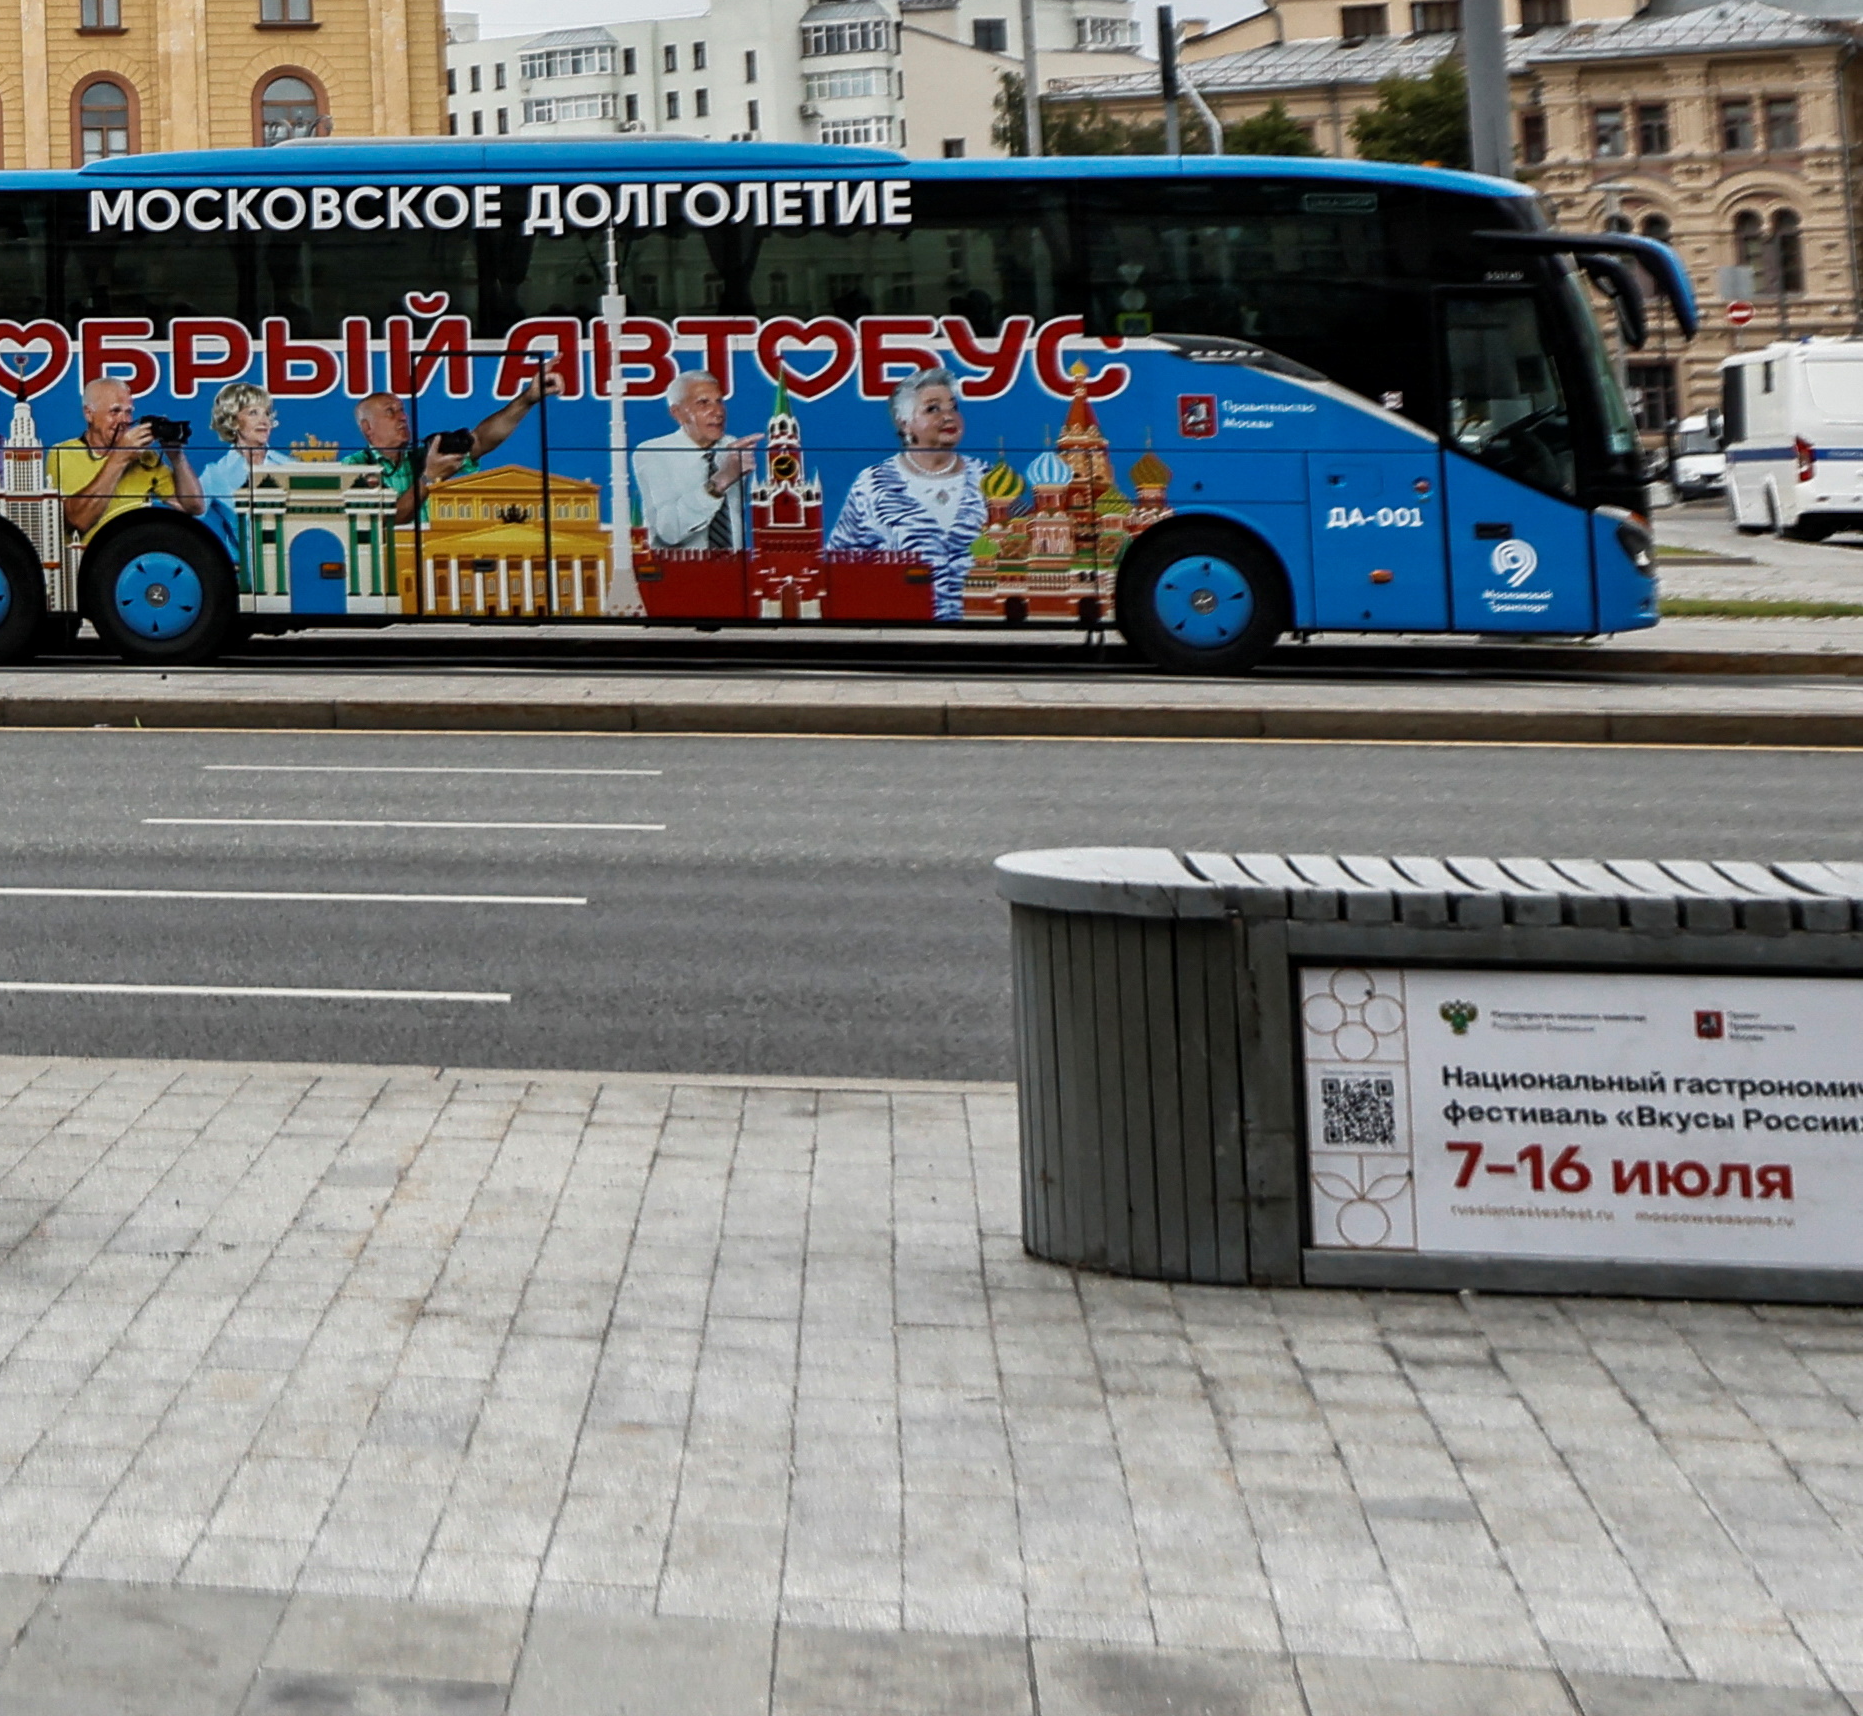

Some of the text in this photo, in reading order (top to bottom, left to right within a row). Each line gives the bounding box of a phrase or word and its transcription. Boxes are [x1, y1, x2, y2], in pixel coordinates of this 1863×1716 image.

[90, 181, 913, 236] МОСКОВСКОЕ ДОЛГОЛЕТИЕ
[493, 315, 1129, 401] АВТОБУС
[1325, 507, 1424, 529] ДА-001
[1442, 1065, 1667, 1093] Национальный
[1443, 1099, 1608, 1129] фестиваль
[1616, 1105, 1735, 1134] «Вкусы
[1612, 1159, 1795, 1201] июля
